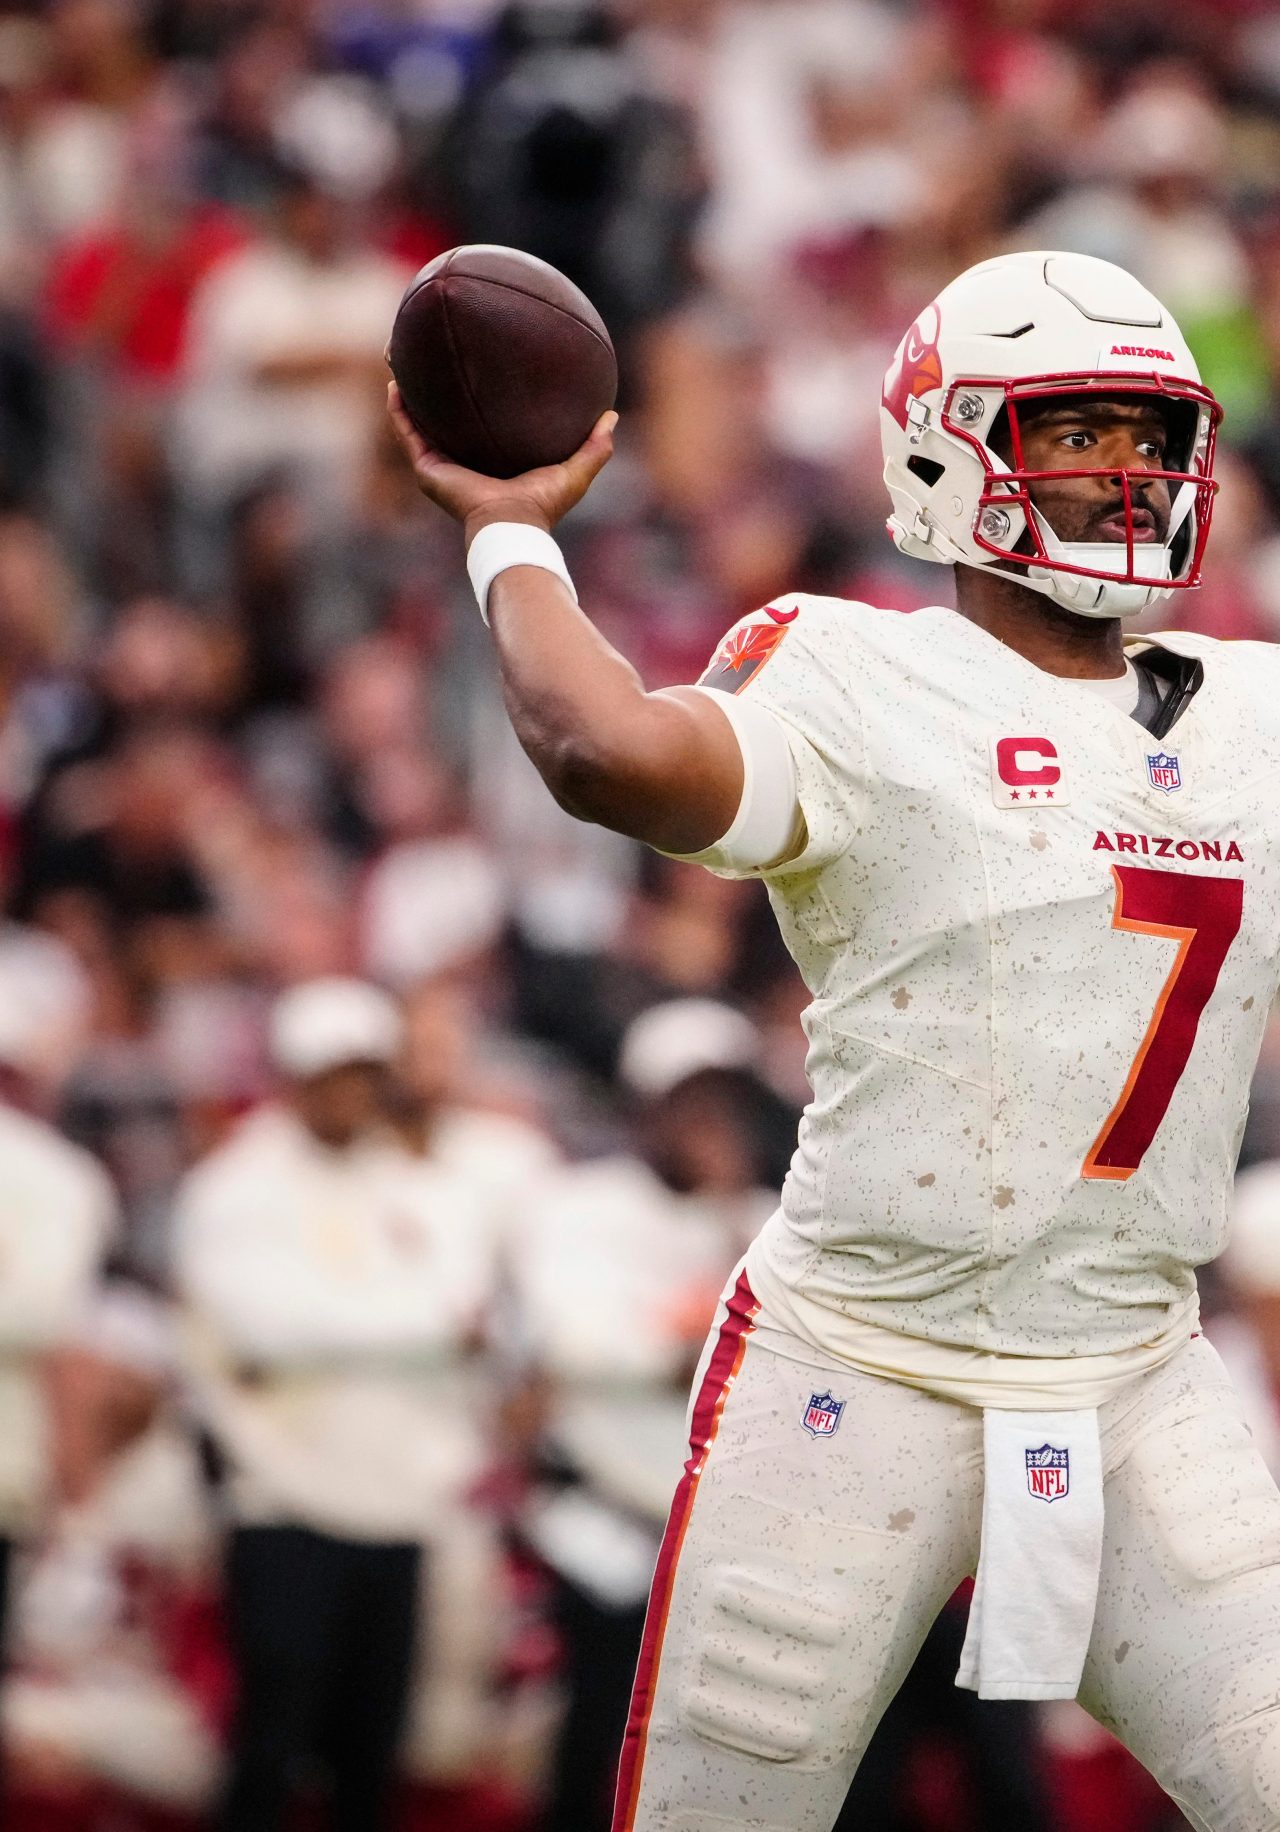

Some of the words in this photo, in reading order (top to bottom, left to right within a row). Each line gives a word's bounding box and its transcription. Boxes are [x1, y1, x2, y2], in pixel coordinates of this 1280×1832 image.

[1110, 345, 1176, 361] ARIZONA
[996, 737, 1061, 786] C
[1153, 768, 1179, 786] NFL
[1092, 830, 1244, 862] ARIZONA
[1080, 864, 1244, 1181] 7
[806, 1407, 832, 1431] NFL
[1030, 1469, 1065, 1496] NFL
